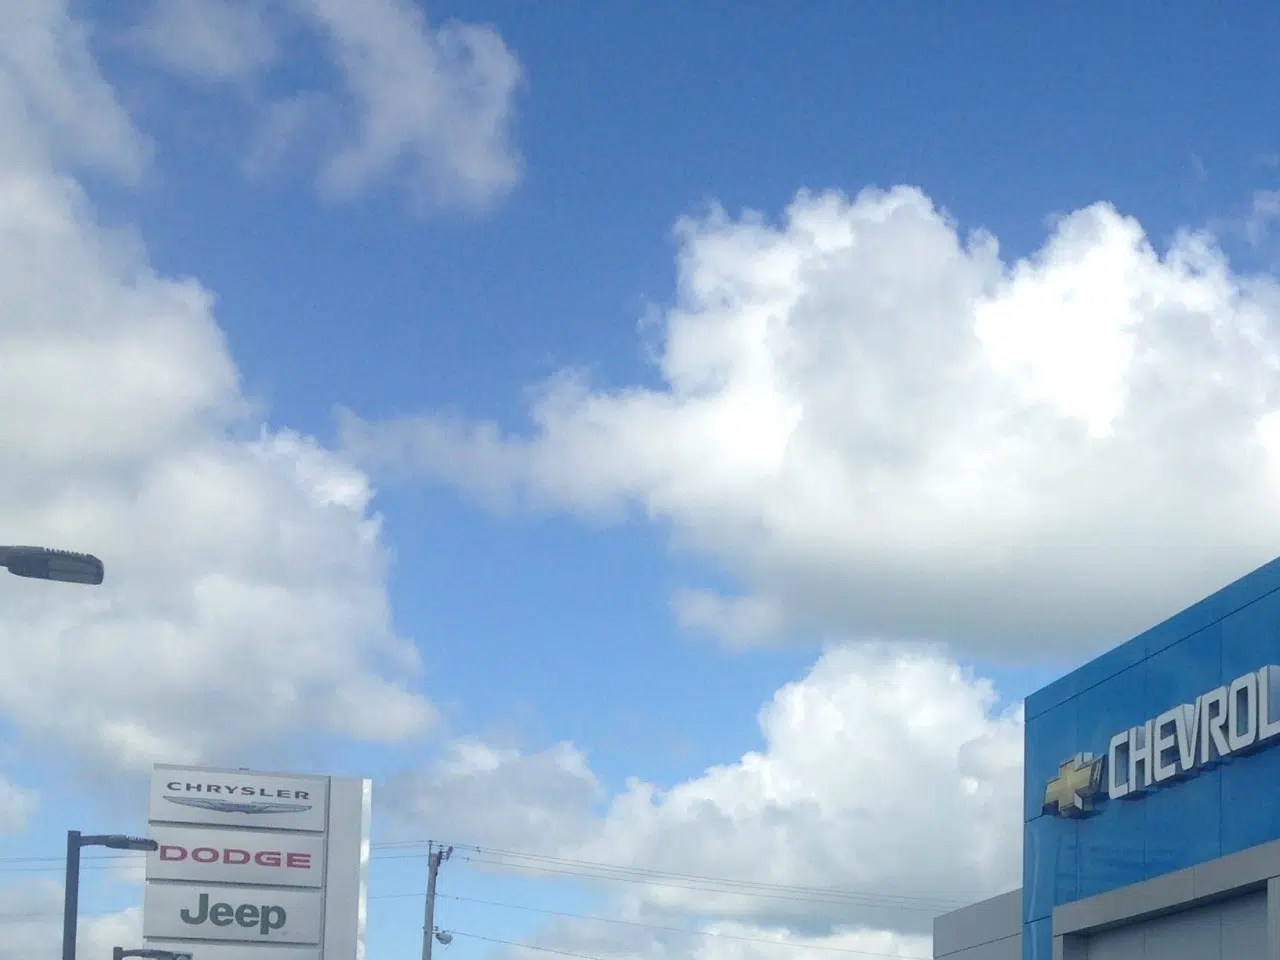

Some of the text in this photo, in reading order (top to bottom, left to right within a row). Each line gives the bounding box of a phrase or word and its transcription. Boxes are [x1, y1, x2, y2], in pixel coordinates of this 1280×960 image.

[166, 782, 310, 800] CHRYSLER
[159, 845, 311, 869] DODGE
[180, 893, 287, 935] Jeep
